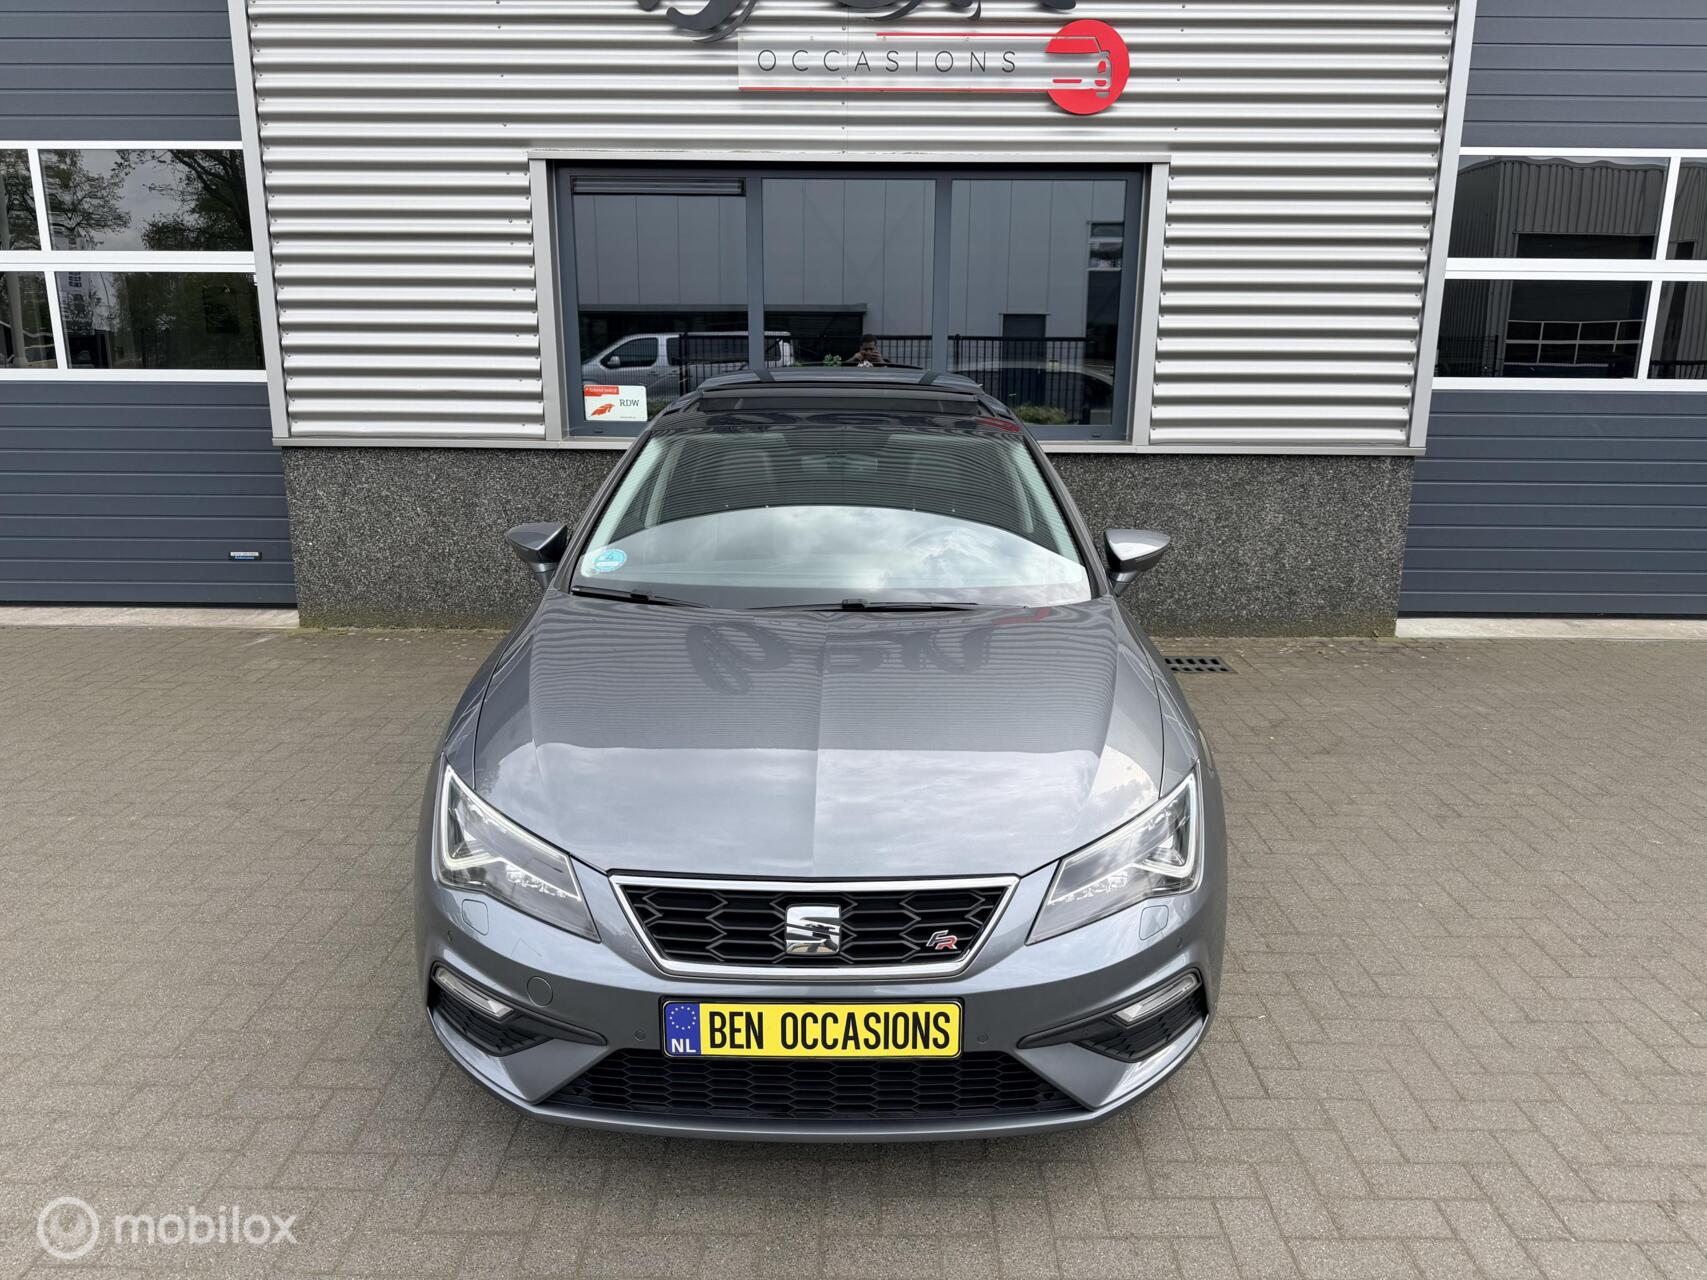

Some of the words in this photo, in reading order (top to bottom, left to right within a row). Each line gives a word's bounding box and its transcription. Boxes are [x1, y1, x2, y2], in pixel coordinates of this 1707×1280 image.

[757, 49, 1016, 72] OCCASIONS
[619, 399, 640, 407] RDW
[708, 1011, 764, 1050] BEN
[780, 1011, 951, 1050] OCCASIONS
[671, 1038, 697, 1053] NL
